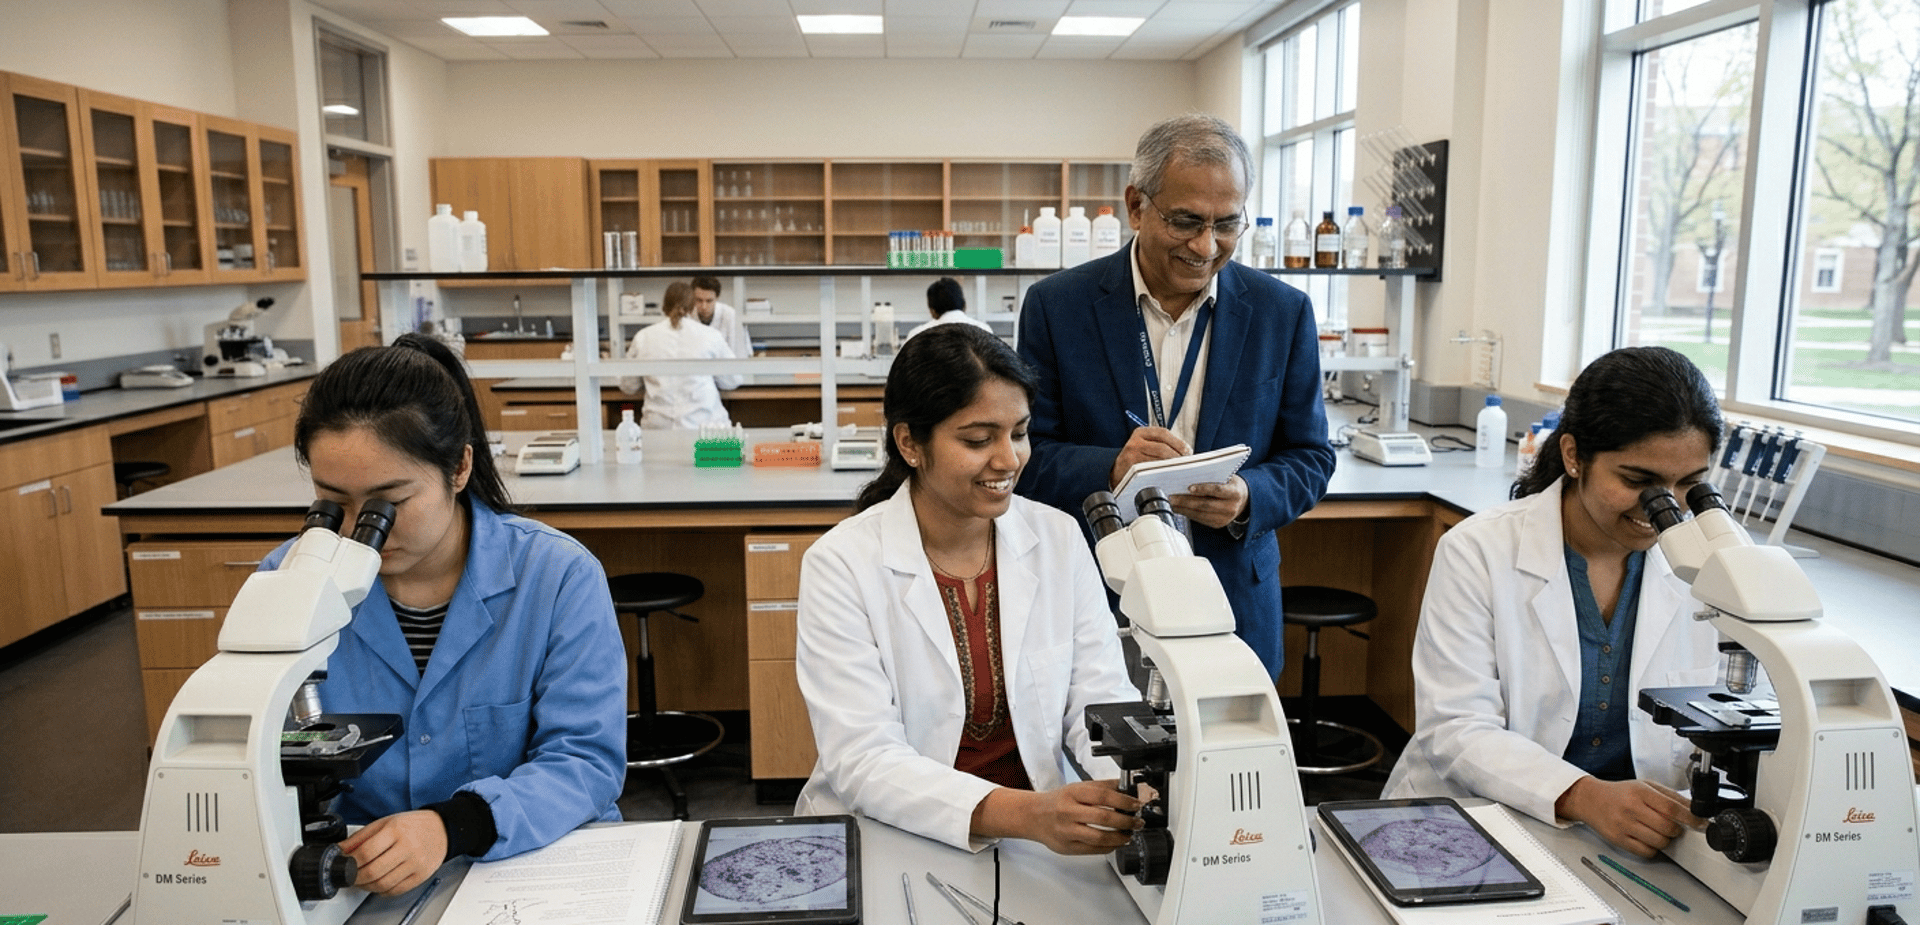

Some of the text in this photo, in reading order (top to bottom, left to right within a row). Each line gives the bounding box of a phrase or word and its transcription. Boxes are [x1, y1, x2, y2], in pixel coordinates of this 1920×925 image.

[1815, 831, 1862, 842] DM Series
[1202, 855, 1220, 867] DM
[155, 873, 207, 884] DM Series
